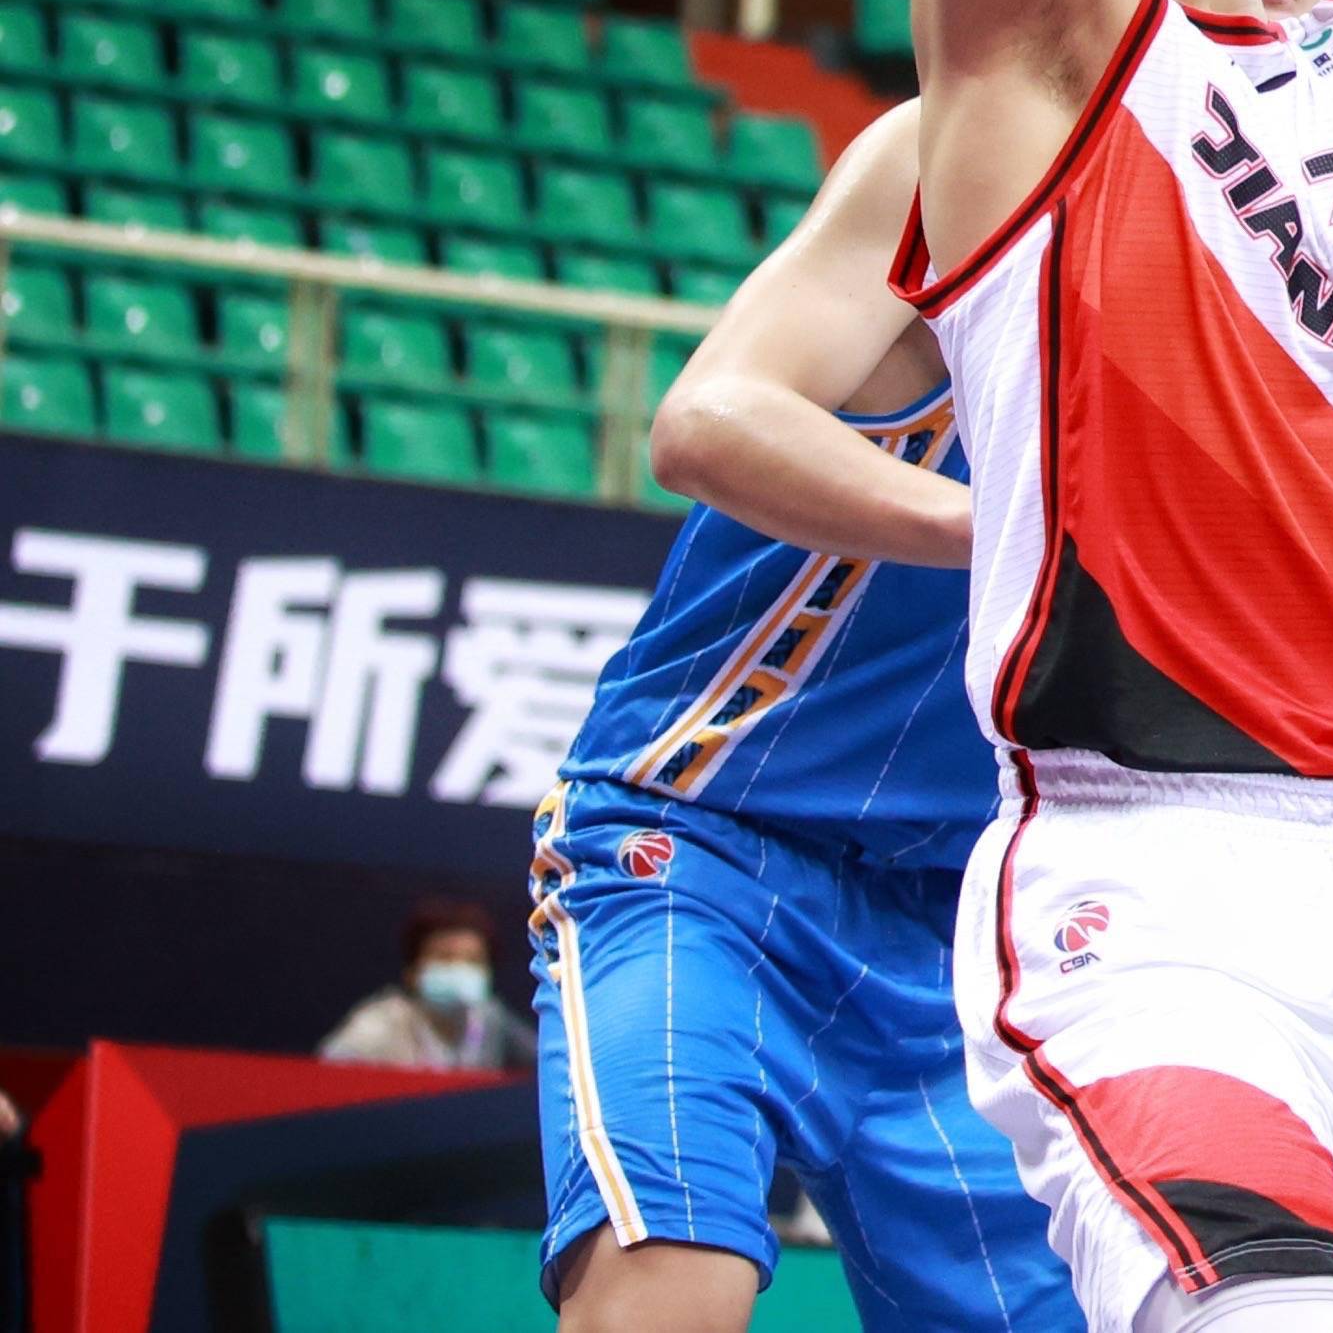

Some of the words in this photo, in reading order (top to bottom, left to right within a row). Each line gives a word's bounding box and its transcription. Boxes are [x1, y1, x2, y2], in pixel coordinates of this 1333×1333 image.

[0, 528, 650, 809] 于所爱
[1060, 952, 1102, 974] CBA
